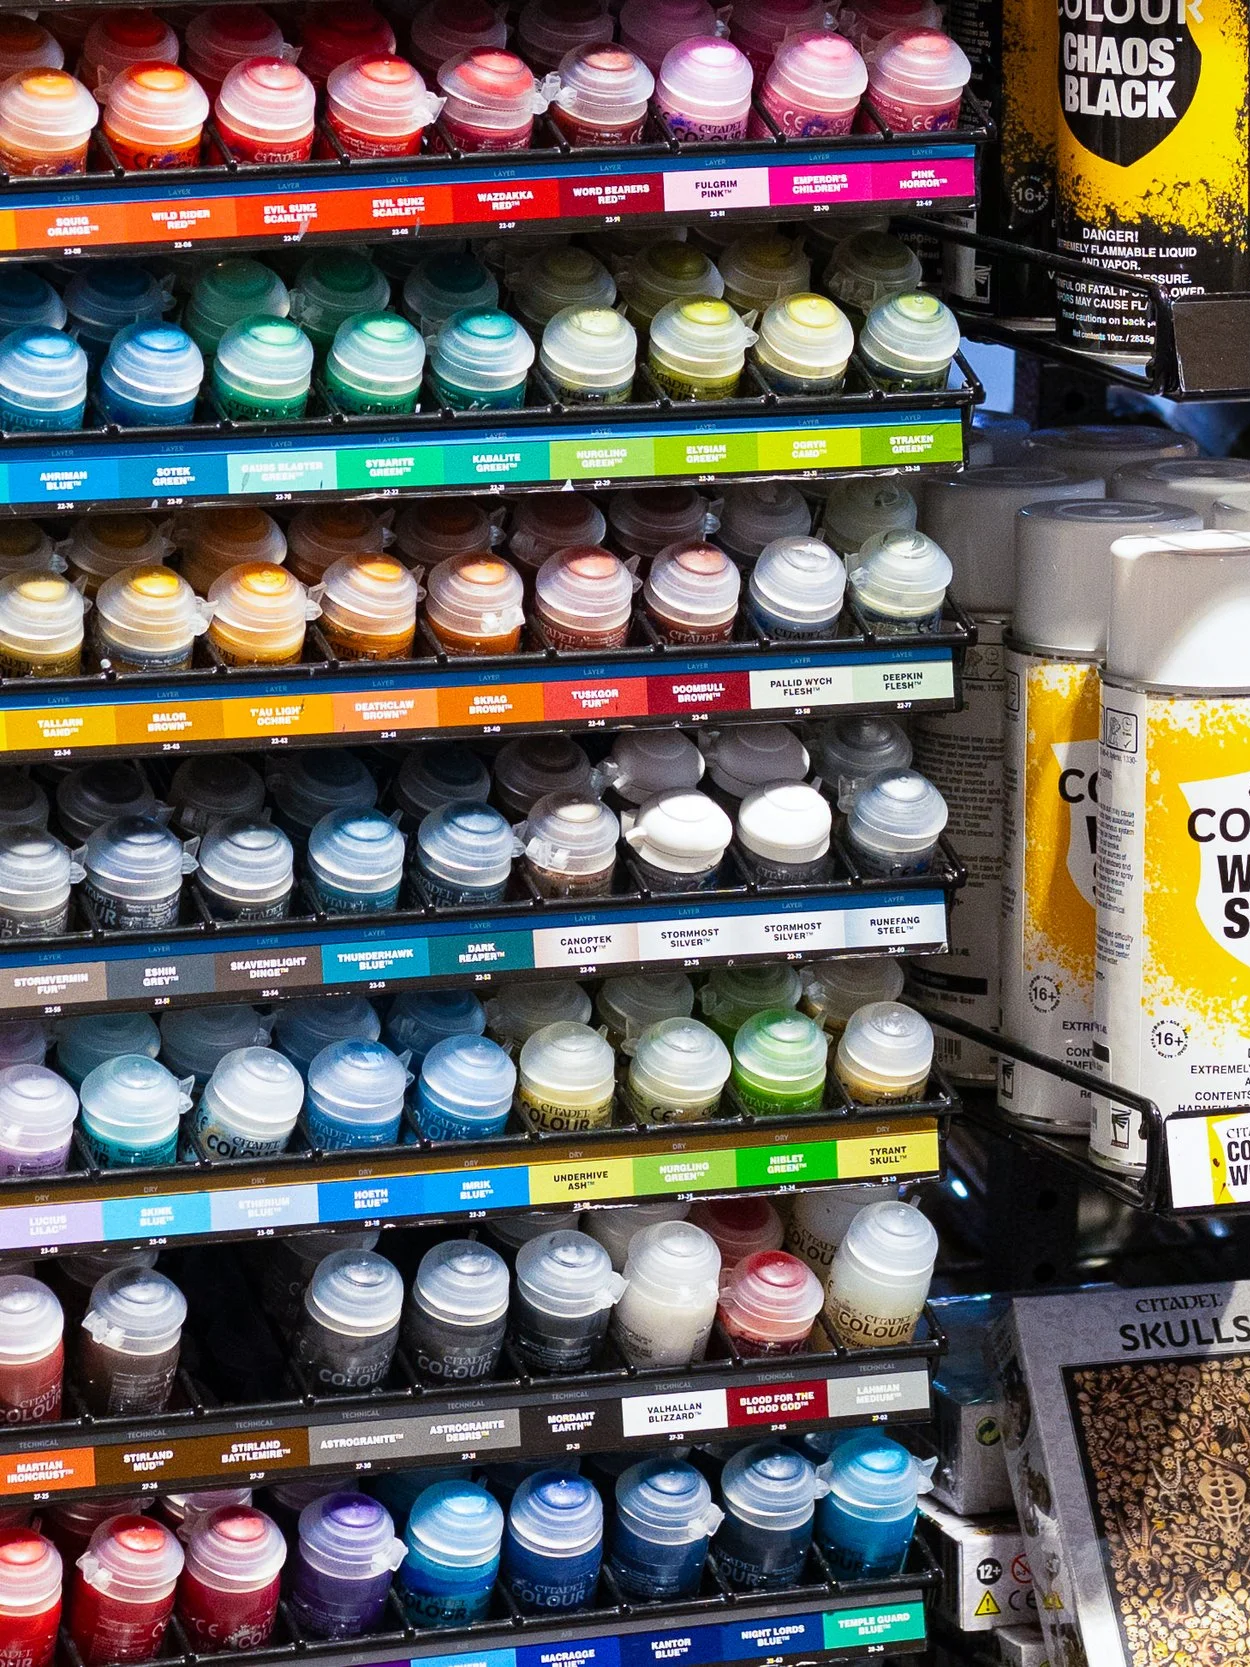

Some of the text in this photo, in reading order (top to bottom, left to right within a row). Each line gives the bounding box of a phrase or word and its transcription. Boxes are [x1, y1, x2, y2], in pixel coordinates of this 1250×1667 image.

[1063, 32, 1177, 76] CHAOS
[1064, 74, 1177, 118] BLACK
[911, 170, 935, 179] PINK
[573, 184, 649, 197] WORD BEARERS
[695, 179, 738, 190] FULGRIM
[477, 190, 533, 201] WAZDAKKA
[1016, 188, 1044, 201] 16+
[264, 203, 317, 215] EVIL SUNZ
[372, 197, 425, 209] EVIL SUNZ
[152, 209, 210, 221] WILD RIDER
[1082, 228, 1139, 243] DANGER!
[1091, 246, 1197, 258] FLAMMABLE LIQUID
[1101, 259, 1141, 271] VAPOR.
[1088, 285, 1117, 296] FATAL
[1093, 297, 1129, 310] CAUSE
[1108, 315, 1120, 325] on
[1122, 316, 1146, 327] back
[889, 434, 934, 445] STRAKEN
[686, 445, 726, 455] ELYSIAN
[473, 453, 521, 464] KABALITE
[40, 471, 88, 481] AHRIMAN
[156, 467, 191, 476] SOTEK
[770, 677, 832, 688] PALLID WYCH
[883, 672, 923, 682] DEEPKIN
[571, 688, 619, 700] TUSKGOR
[672, 683, 725, 694] DOOMBULL
[355, 700, 414, 711] DEATHCLAW
[764, 922, 822, 933] STORMHOST
[870, 916, 920, 927] RUNEFANG
[661, 928, 720, 940] STORMHOST
[560, 936, 612, 946] CANOPTEK
[467, 943, 496, 953] DARK
[337, 948, 414, 962] THUNDERHAWK
[230, 957, 307, 971] SKAVENBLIGHT
[145, 967, 176, 977] ESHIN
[14, 973, 89, 987] STORMVERMIN
[1033, 987, 1056, 1002] 16+
[1155, 1032, 1184, 1047] 16+
[869, 1146, 907, 1156] TYRANT
[770, 1154, 804, 1164] NIBLET
[659, 1162, 709, 1174] NURGLING
[553, 1171, 609, 1183] UNDERHIVE
[462, 1180, 491, 1190] IMRIK
[354, 1189, 388, 1199] HOETH
[1135, 1293, 1223, 1314] CITADEL
[839, 1311, 910, 1337] COLOUR
[740, 1392, 814, 1407] BLOOD FOR THE
[647, 1402, 702, 1414] VALHALLAN
[746, 1404, 777, 1415] BLOOD
[547, 1412, 595, 1423] MORDANT
[430, 1420, 505, 1434] ASTROGRANITE
[231, 1440, 280, 1453] STIRLAND
[123, 1450, 173, 1463] STIRLAND
[17, 1461, 63, 1473] MARTIAN
[978, 1564, 1000, 1579] 12+
[838, 1613, 910, 1629] TEMPLE GUARD
[741, 1625, 805, 1640] NIGHT LORDS
[651, 1639, 691, 1650] KANTOR
[541, 1649, 595, 1663] MACRAGGE
